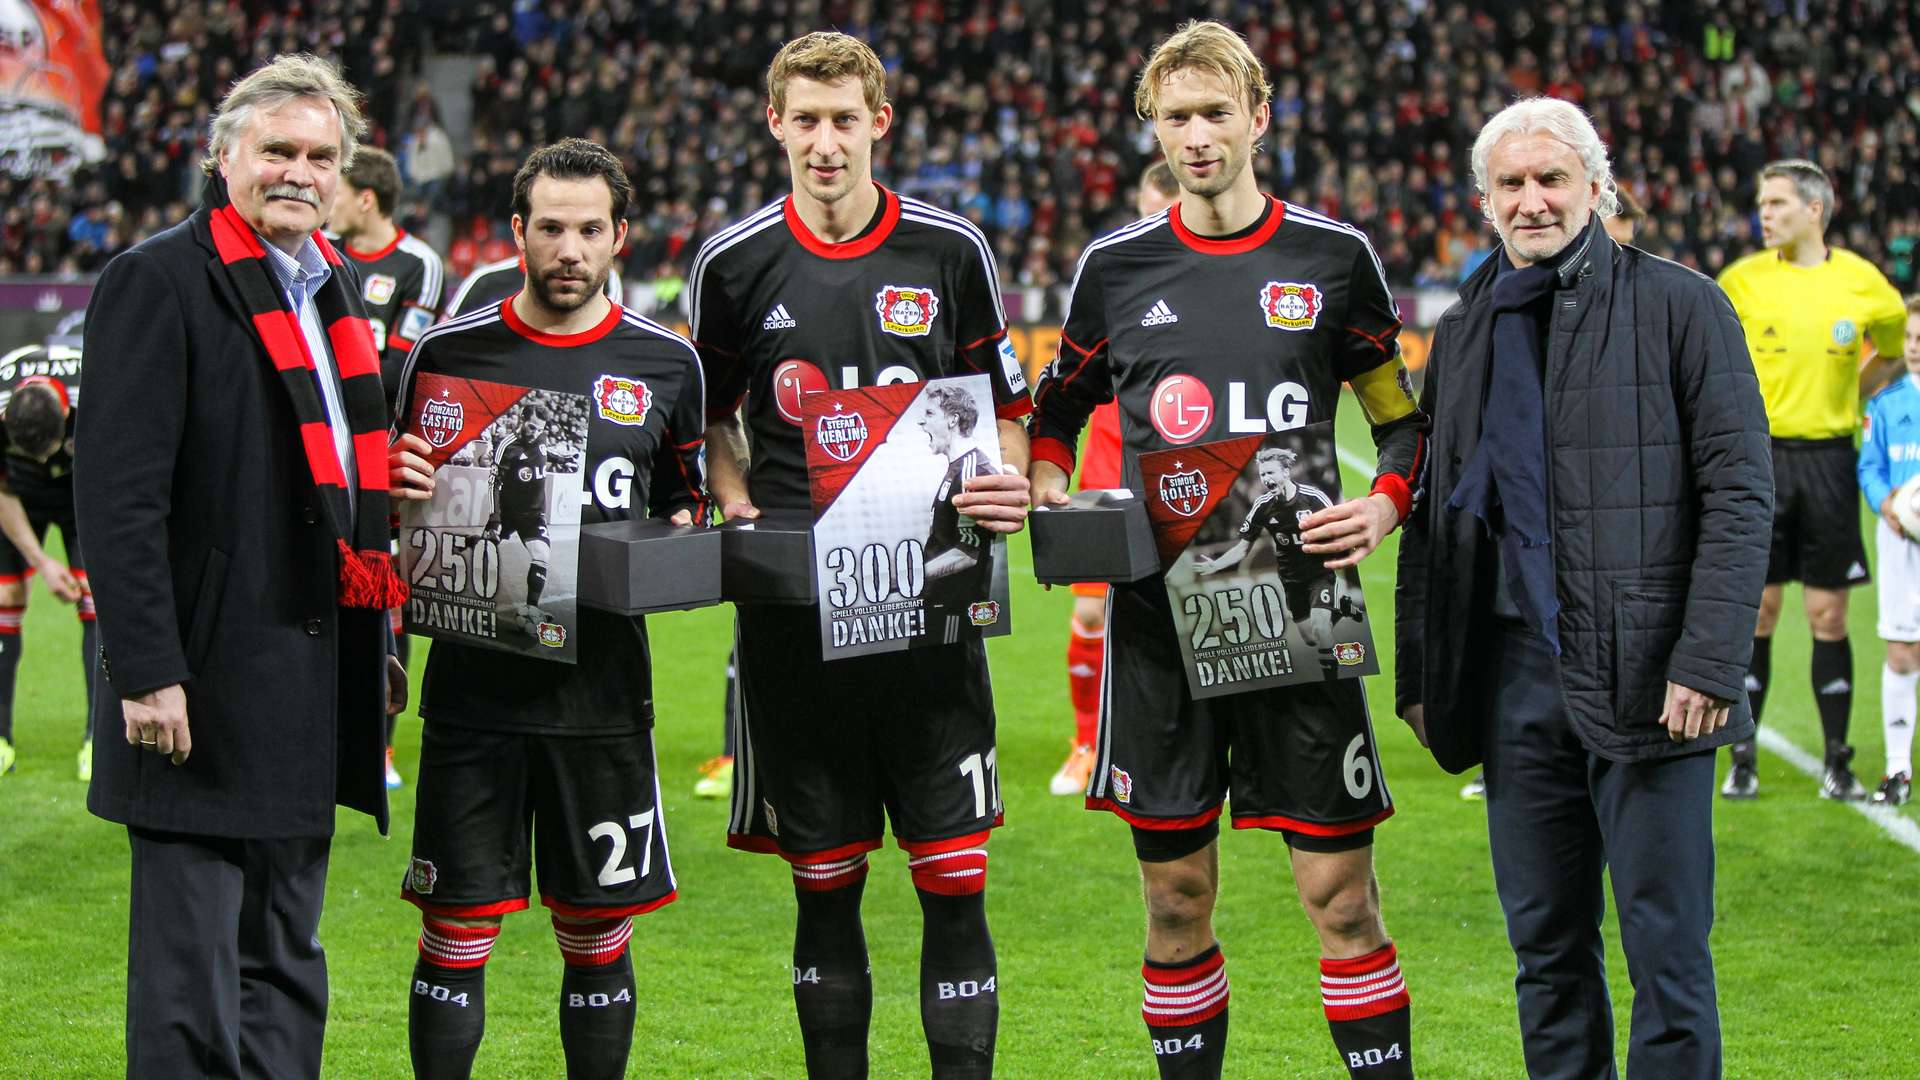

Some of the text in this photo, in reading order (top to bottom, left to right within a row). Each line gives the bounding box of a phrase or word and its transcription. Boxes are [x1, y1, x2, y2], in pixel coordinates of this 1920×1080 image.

[764, 318, 796, 330] adidas
[1141, 314, 1178, 327] adidas
[20, 359, 82, 378] AYER
[429, 404, 459, 417] GONZALO
[1229, 381, 1309, 433] LG
[420, 413, 463, 431] CASTRO
[826, 418, 856, 430] STEFAN
[432, 431, 446, 443] 27
[838, 443, 850, 457] 11
[1169, 475, 1195, 487] SIMON
[1160, 483, 1209, 502] ROLFES
[1183, 500, 1191, 513] 6
[411, 528, 499, 598] 250
[827, 539, 925, 608] 300
[1320, 588, 1331, 604] 6
[411, 598, 497, 638] DANKE!
[832, 599, 924, 619] SPIELE VOLLER LEIDENSCHAFT
[1184, 583, 1285, 650] 250
[832, 609, 926, 647] DANKE!
[1194, 640, 1287, 660] SPIELE VOLLER LEIDENSCHAFT
[1196, 649, 1293, 687] DANKE!
[1343, 732, 1372, 800] 6
[959, 747, 996, 819] 11
[588, 806, 655, 887] 27
